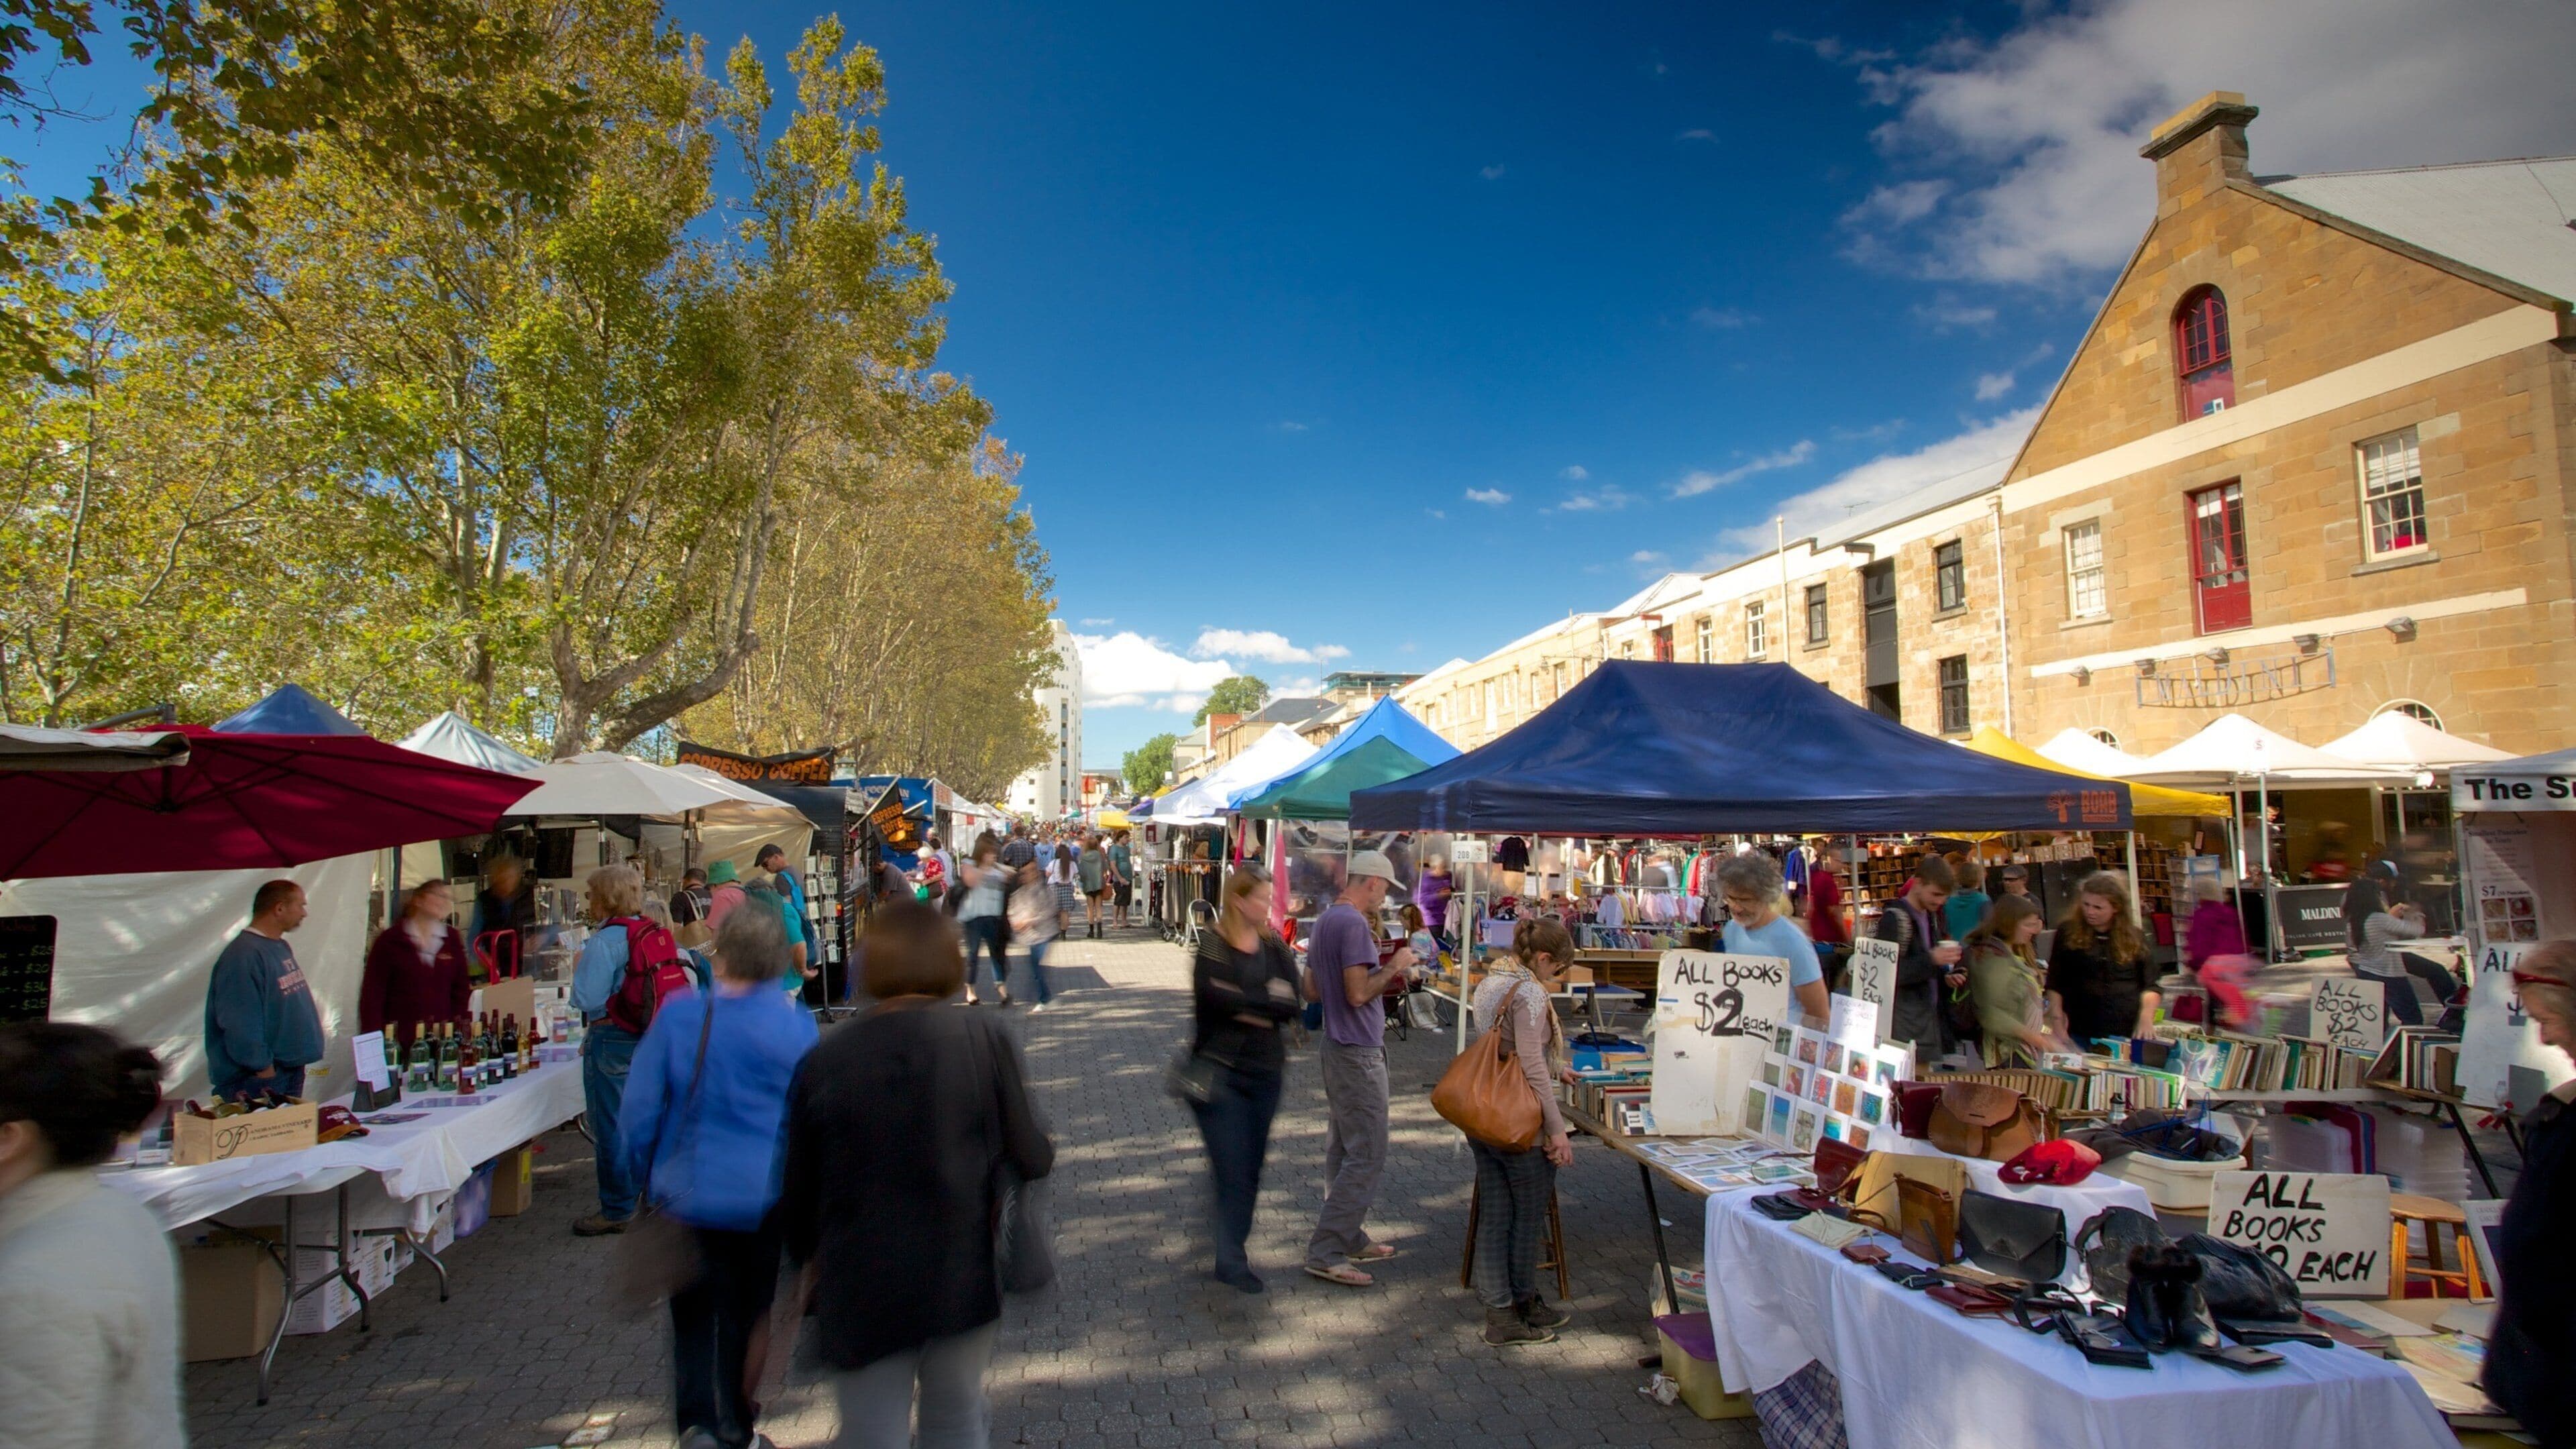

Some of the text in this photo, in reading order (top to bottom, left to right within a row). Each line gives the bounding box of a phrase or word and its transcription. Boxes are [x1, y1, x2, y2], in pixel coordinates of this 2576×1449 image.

[768, 759, 830, 781] COFFEE
[2465, 778, 2532, 800] The
[1457, 850, 1470, 859] 208
[1856, 940, 1870, 956] ALL
[1674, 956, 1782, 988] ALL BOOKS
[1859, 961, 1879, 990] $2
[1862, 987, 1883, 1007] EACH
[2318, 979, 2361, 999] ALL
[1694, 988, 1773, 1037] $2 each
[2314, 996, 2378, 1022] BOOKS
[2326, 1012, 2364, 1035] $2
[2330, 1034, 2369, 1049] EACH
[2242, 1173, 2326, 1210] ALL
[2222, 1210, 2326, 1242] BOOKS
[2296, 1250, 2377, 1283] EACH
